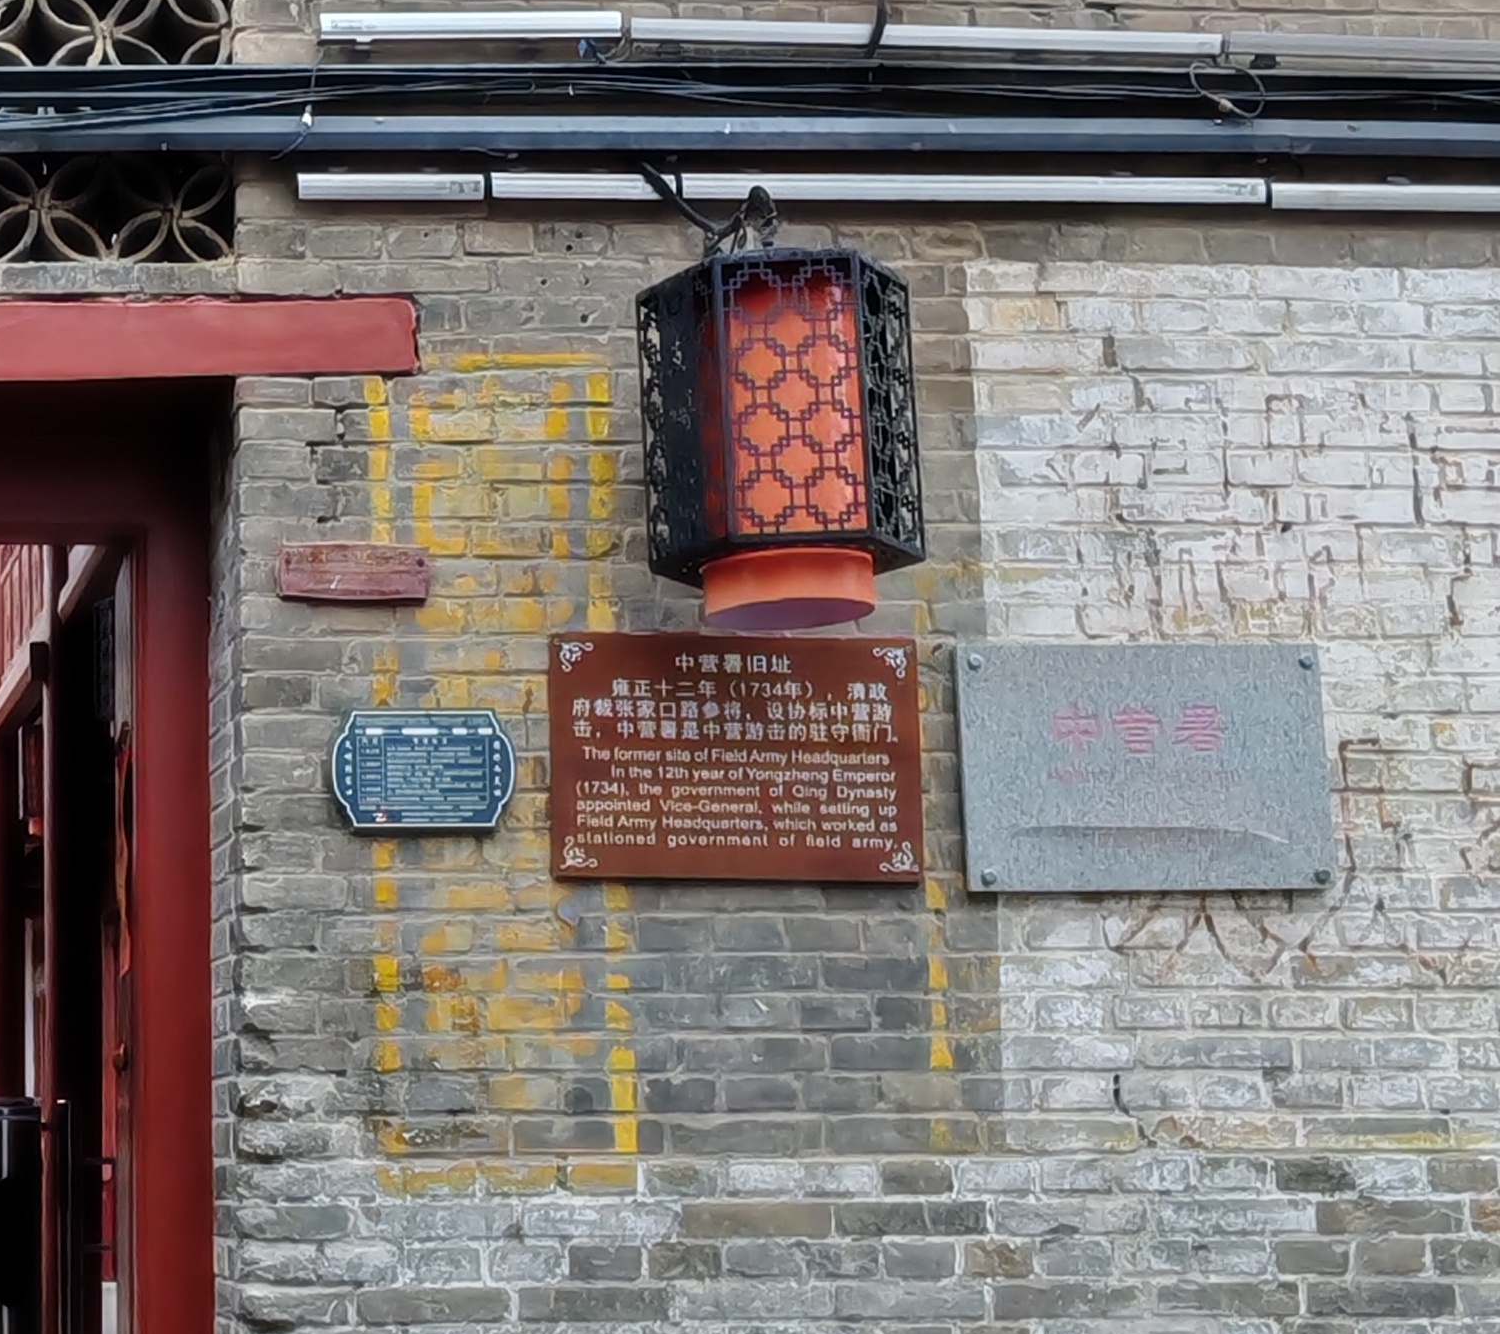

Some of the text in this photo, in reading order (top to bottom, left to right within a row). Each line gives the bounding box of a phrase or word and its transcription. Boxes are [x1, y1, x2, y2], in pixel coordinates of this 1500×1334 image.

[675, 652, 792, 674] 中营署旧址
[582, 746, 890, 767] The former site of Field Army Headquarters
[611, 765, 896, 784] In the 12th year of Yongzheng Emperor
[639, 782, 662, 795] the
[671, 784, 760, 798] government
[769, 785, 783, 797] of
[792, 785, 828, 800] Qing
[837, 786, 897, 801] Dynasty
[576, 799, 651, 813] appointed
[771, 801, 811, 813] while
[819, 802, 870, 817] setting
[878, 804, 898, 818] up
[576, 815, 613, 828] Field
[617, 815, 657, 830] Army
[773, 819, 817, 832] which
[821, 819, 875, 832] worked
[879, 821, 898, 833] as
[577, 831, 656, 845] stationed
[667, 834, 768, 848] government
[779, 834, 795, 847] of
[806, 834, 841, 848] field
